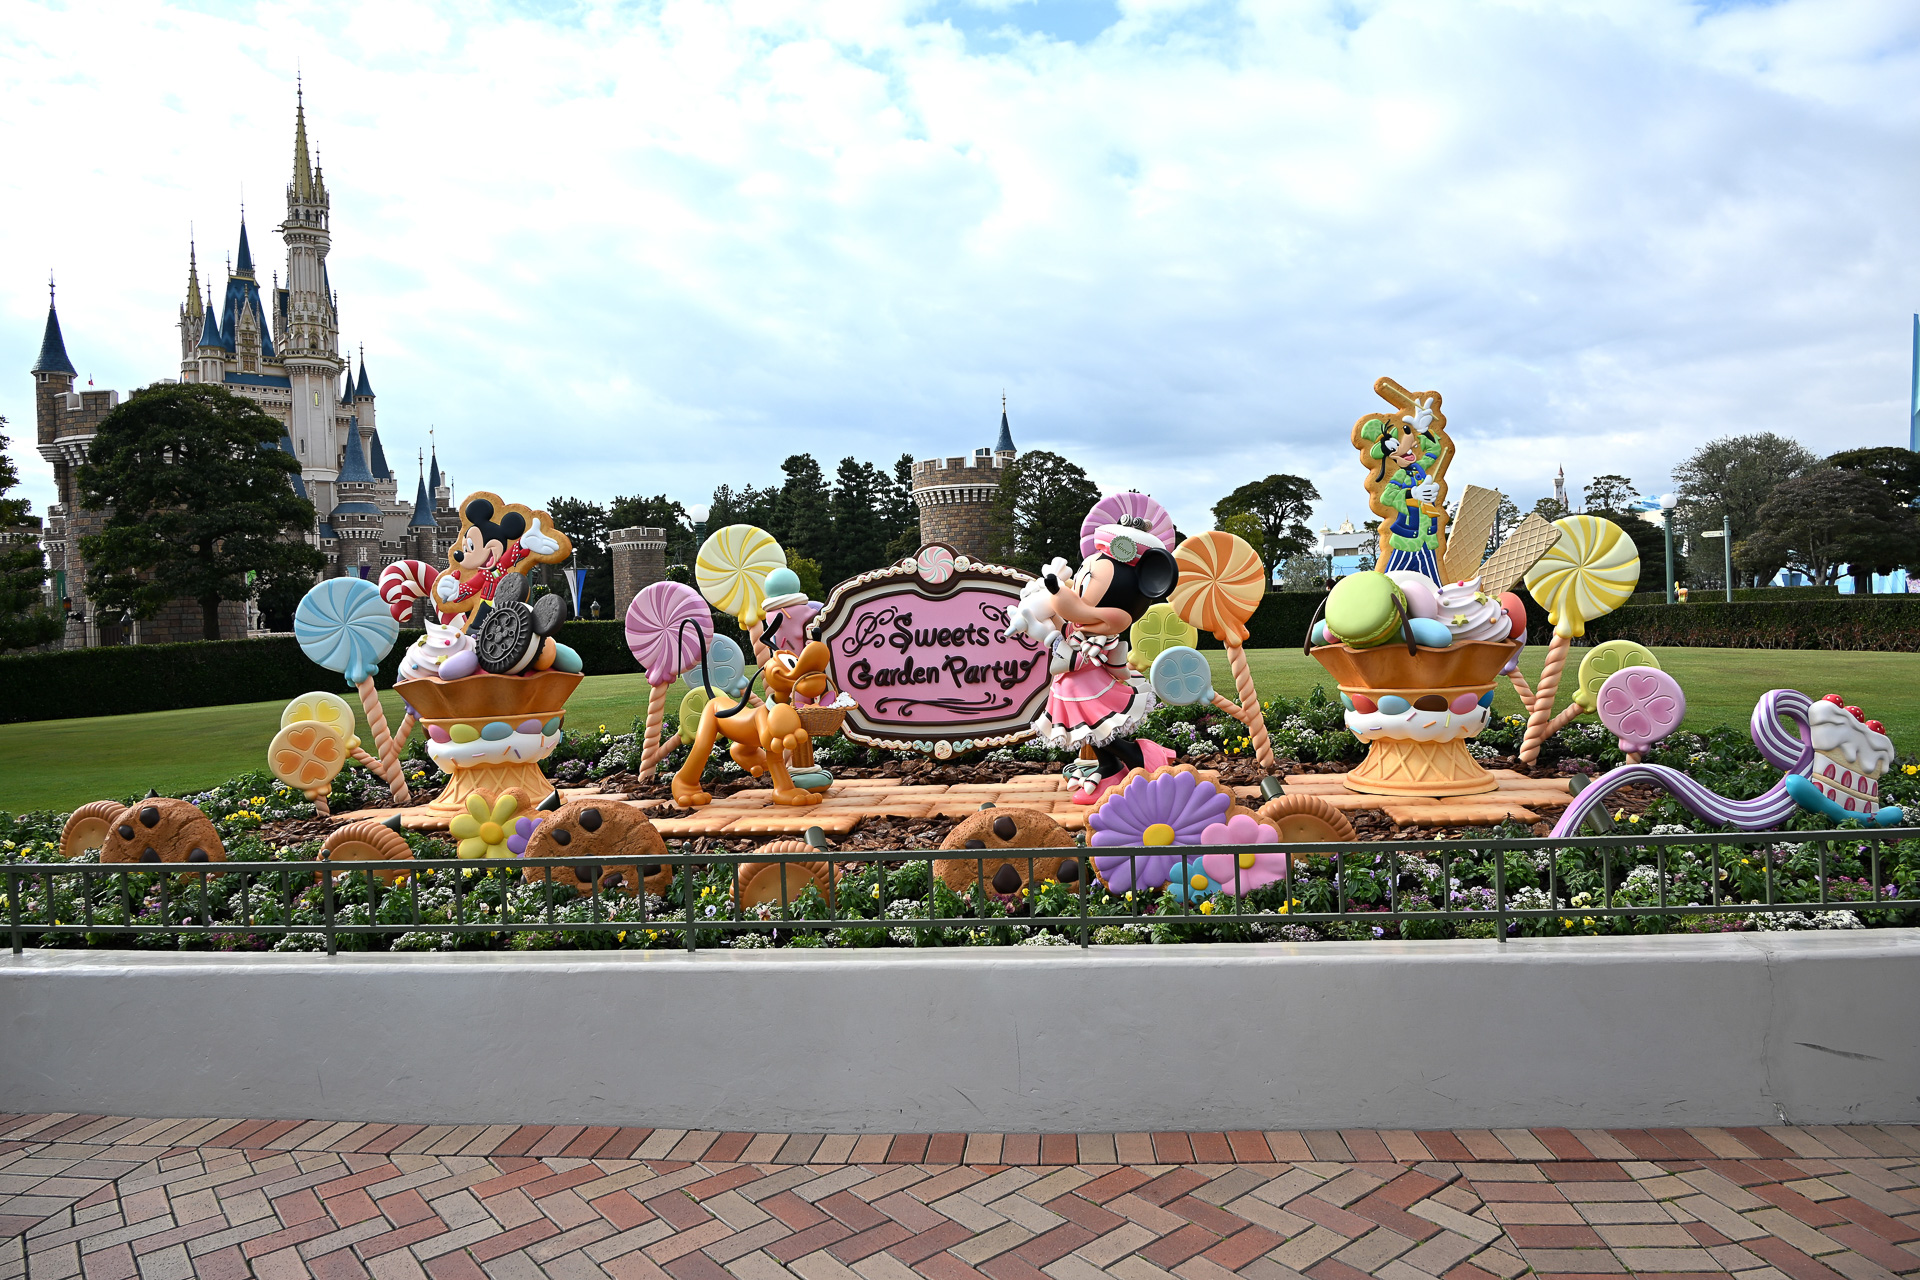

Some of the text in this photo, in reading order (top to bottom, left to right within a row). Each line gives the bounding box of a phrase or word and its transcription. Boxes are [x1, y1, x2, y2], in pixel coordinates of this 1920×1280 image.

[889, 612, 990, 655] Sweets
[847, 650, 1046, 690] Garden Party
